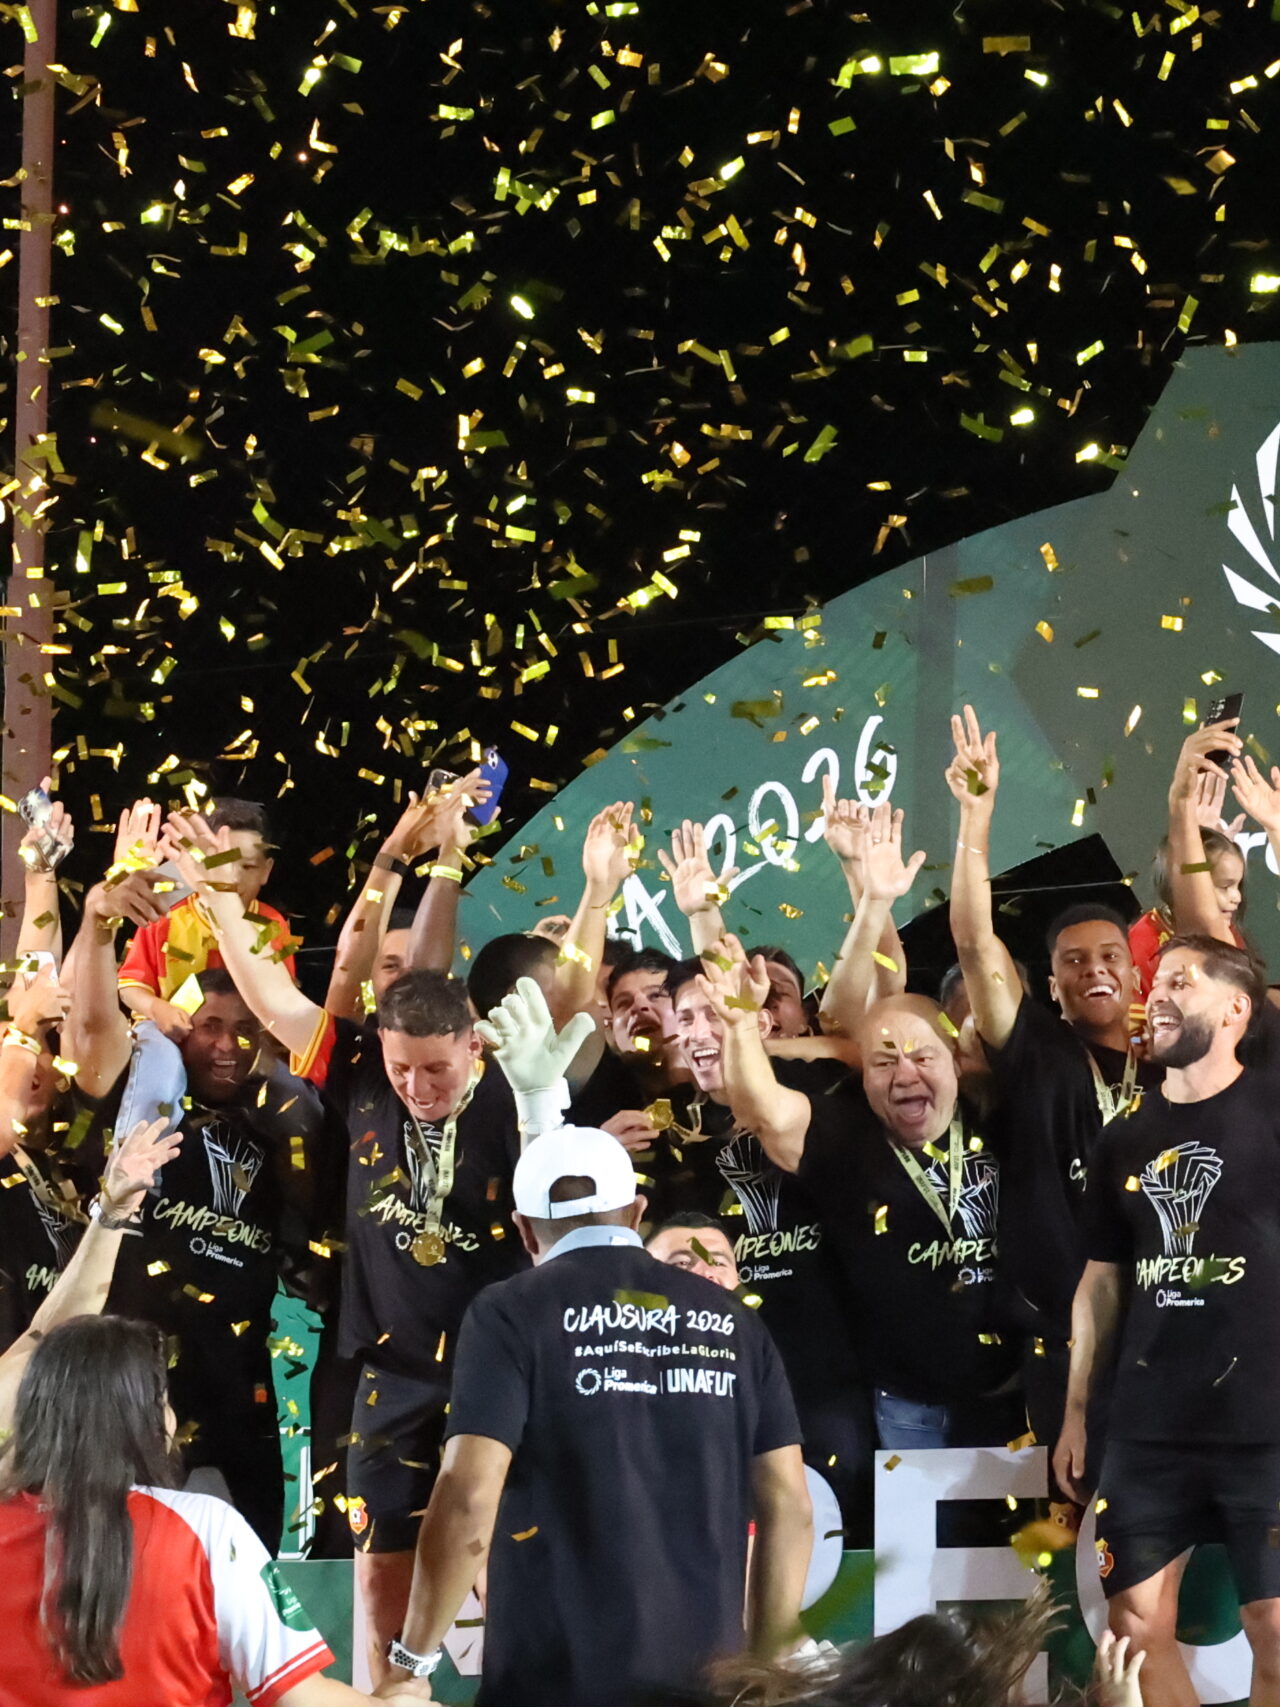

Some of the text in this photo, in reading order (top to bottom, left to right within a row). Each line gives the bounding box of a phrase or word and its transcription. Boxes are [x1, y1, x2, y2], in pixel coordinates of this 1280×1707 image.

[153, 1198, 271, 1253] CAMPEONES
[208, 1241, 223, 1252] Liga
[734, 1223, 821, 1262] PEONES
[206, 1248, 244, 1267] Promerica
[753, 1268, 793, 1281] Promerica
[754, 1264, 770, 1274] Liga
[1167, 1289, 1181, 1299] Liga
[1166, 1297, 1205, 1307] Promerica
[563, 1300, 735, 1336] CLAUSURA 2026
[604, 1366, 627, 1380] Liga
[603, 1379, 657, 1395] Promerica
[666, 1368, 736, 1398] UNAFUT
